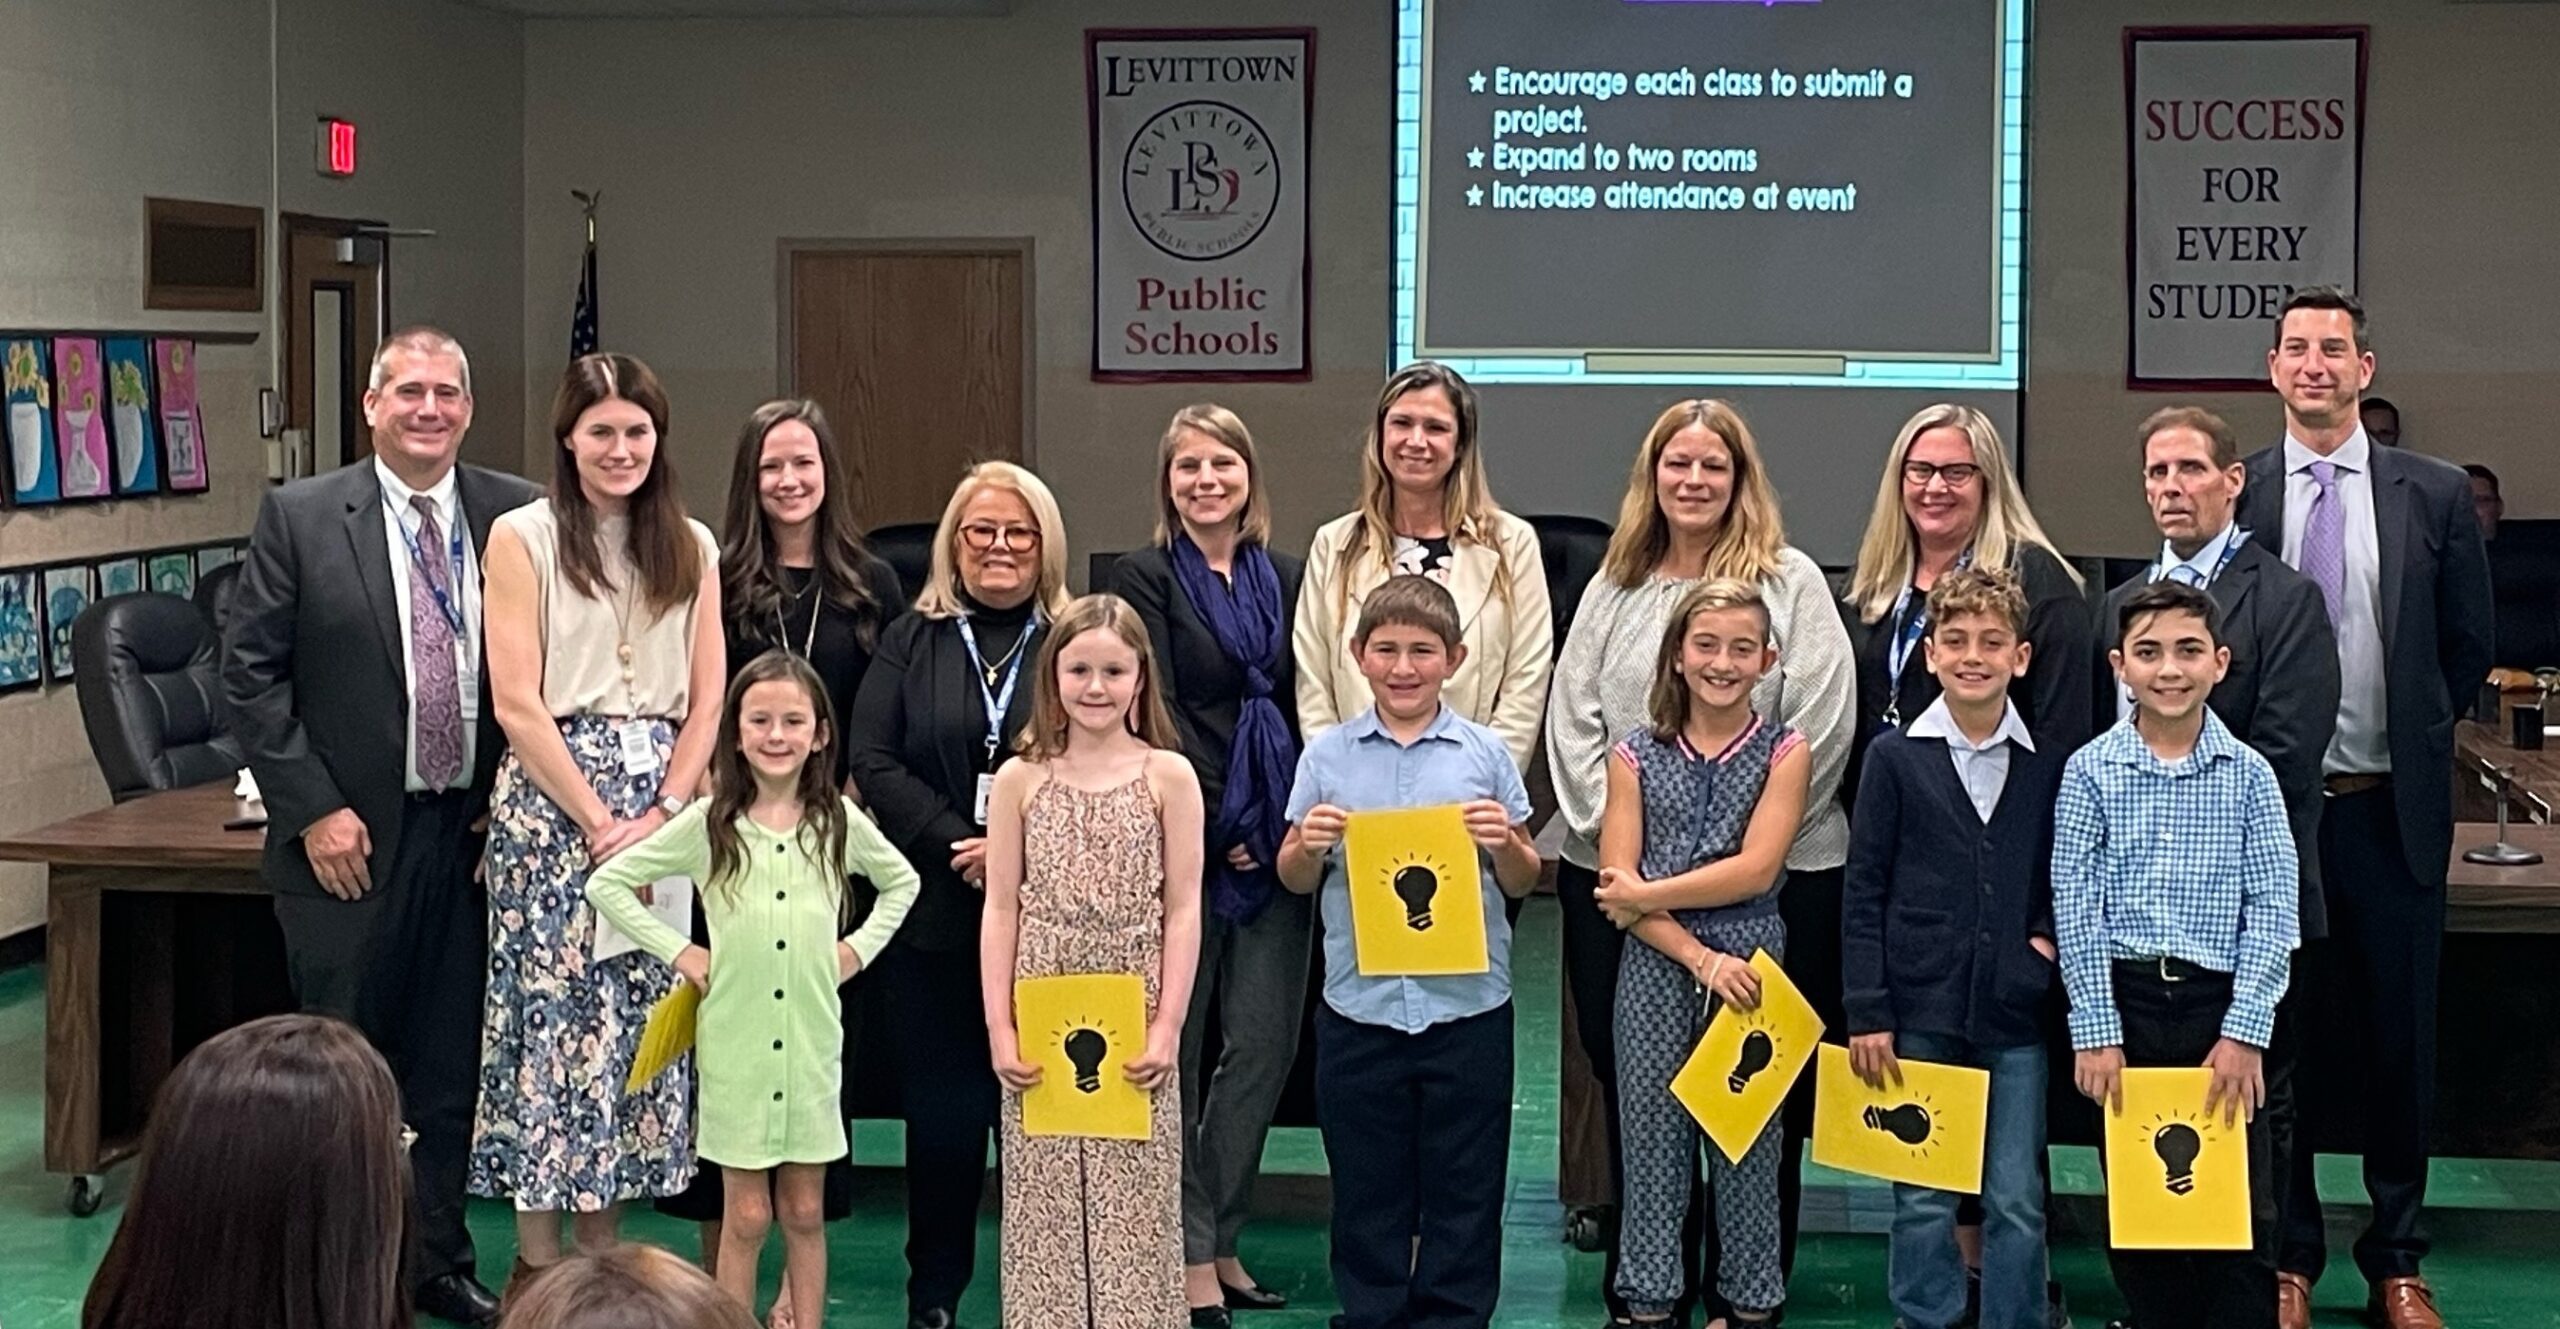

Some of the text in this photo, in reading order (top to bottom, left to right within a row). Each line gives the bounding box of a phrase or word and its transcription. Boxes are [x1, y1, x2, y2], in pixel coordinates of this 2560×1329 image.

[1105, 56, 1296, 96] LEVITTOWN
[1494, 66, 1914, 100] Encourage each class to submit a
[1493, 103, 1588, 140] project.
[2145, 99, 2345, 141] SUCCESS
[1493, 141, 1758, 178] Expand to two rooms
[1492, 179, 1857, 212] Increase attendance at event
[2202, 167, 2281, 203] FOR
[2176, 226, 2308, 262] EVERY
[1136, 276, 1267, 312] Public
[2148, 283, 2300, 320] STUDE
[1125, 321, 1279, 356] Schools
